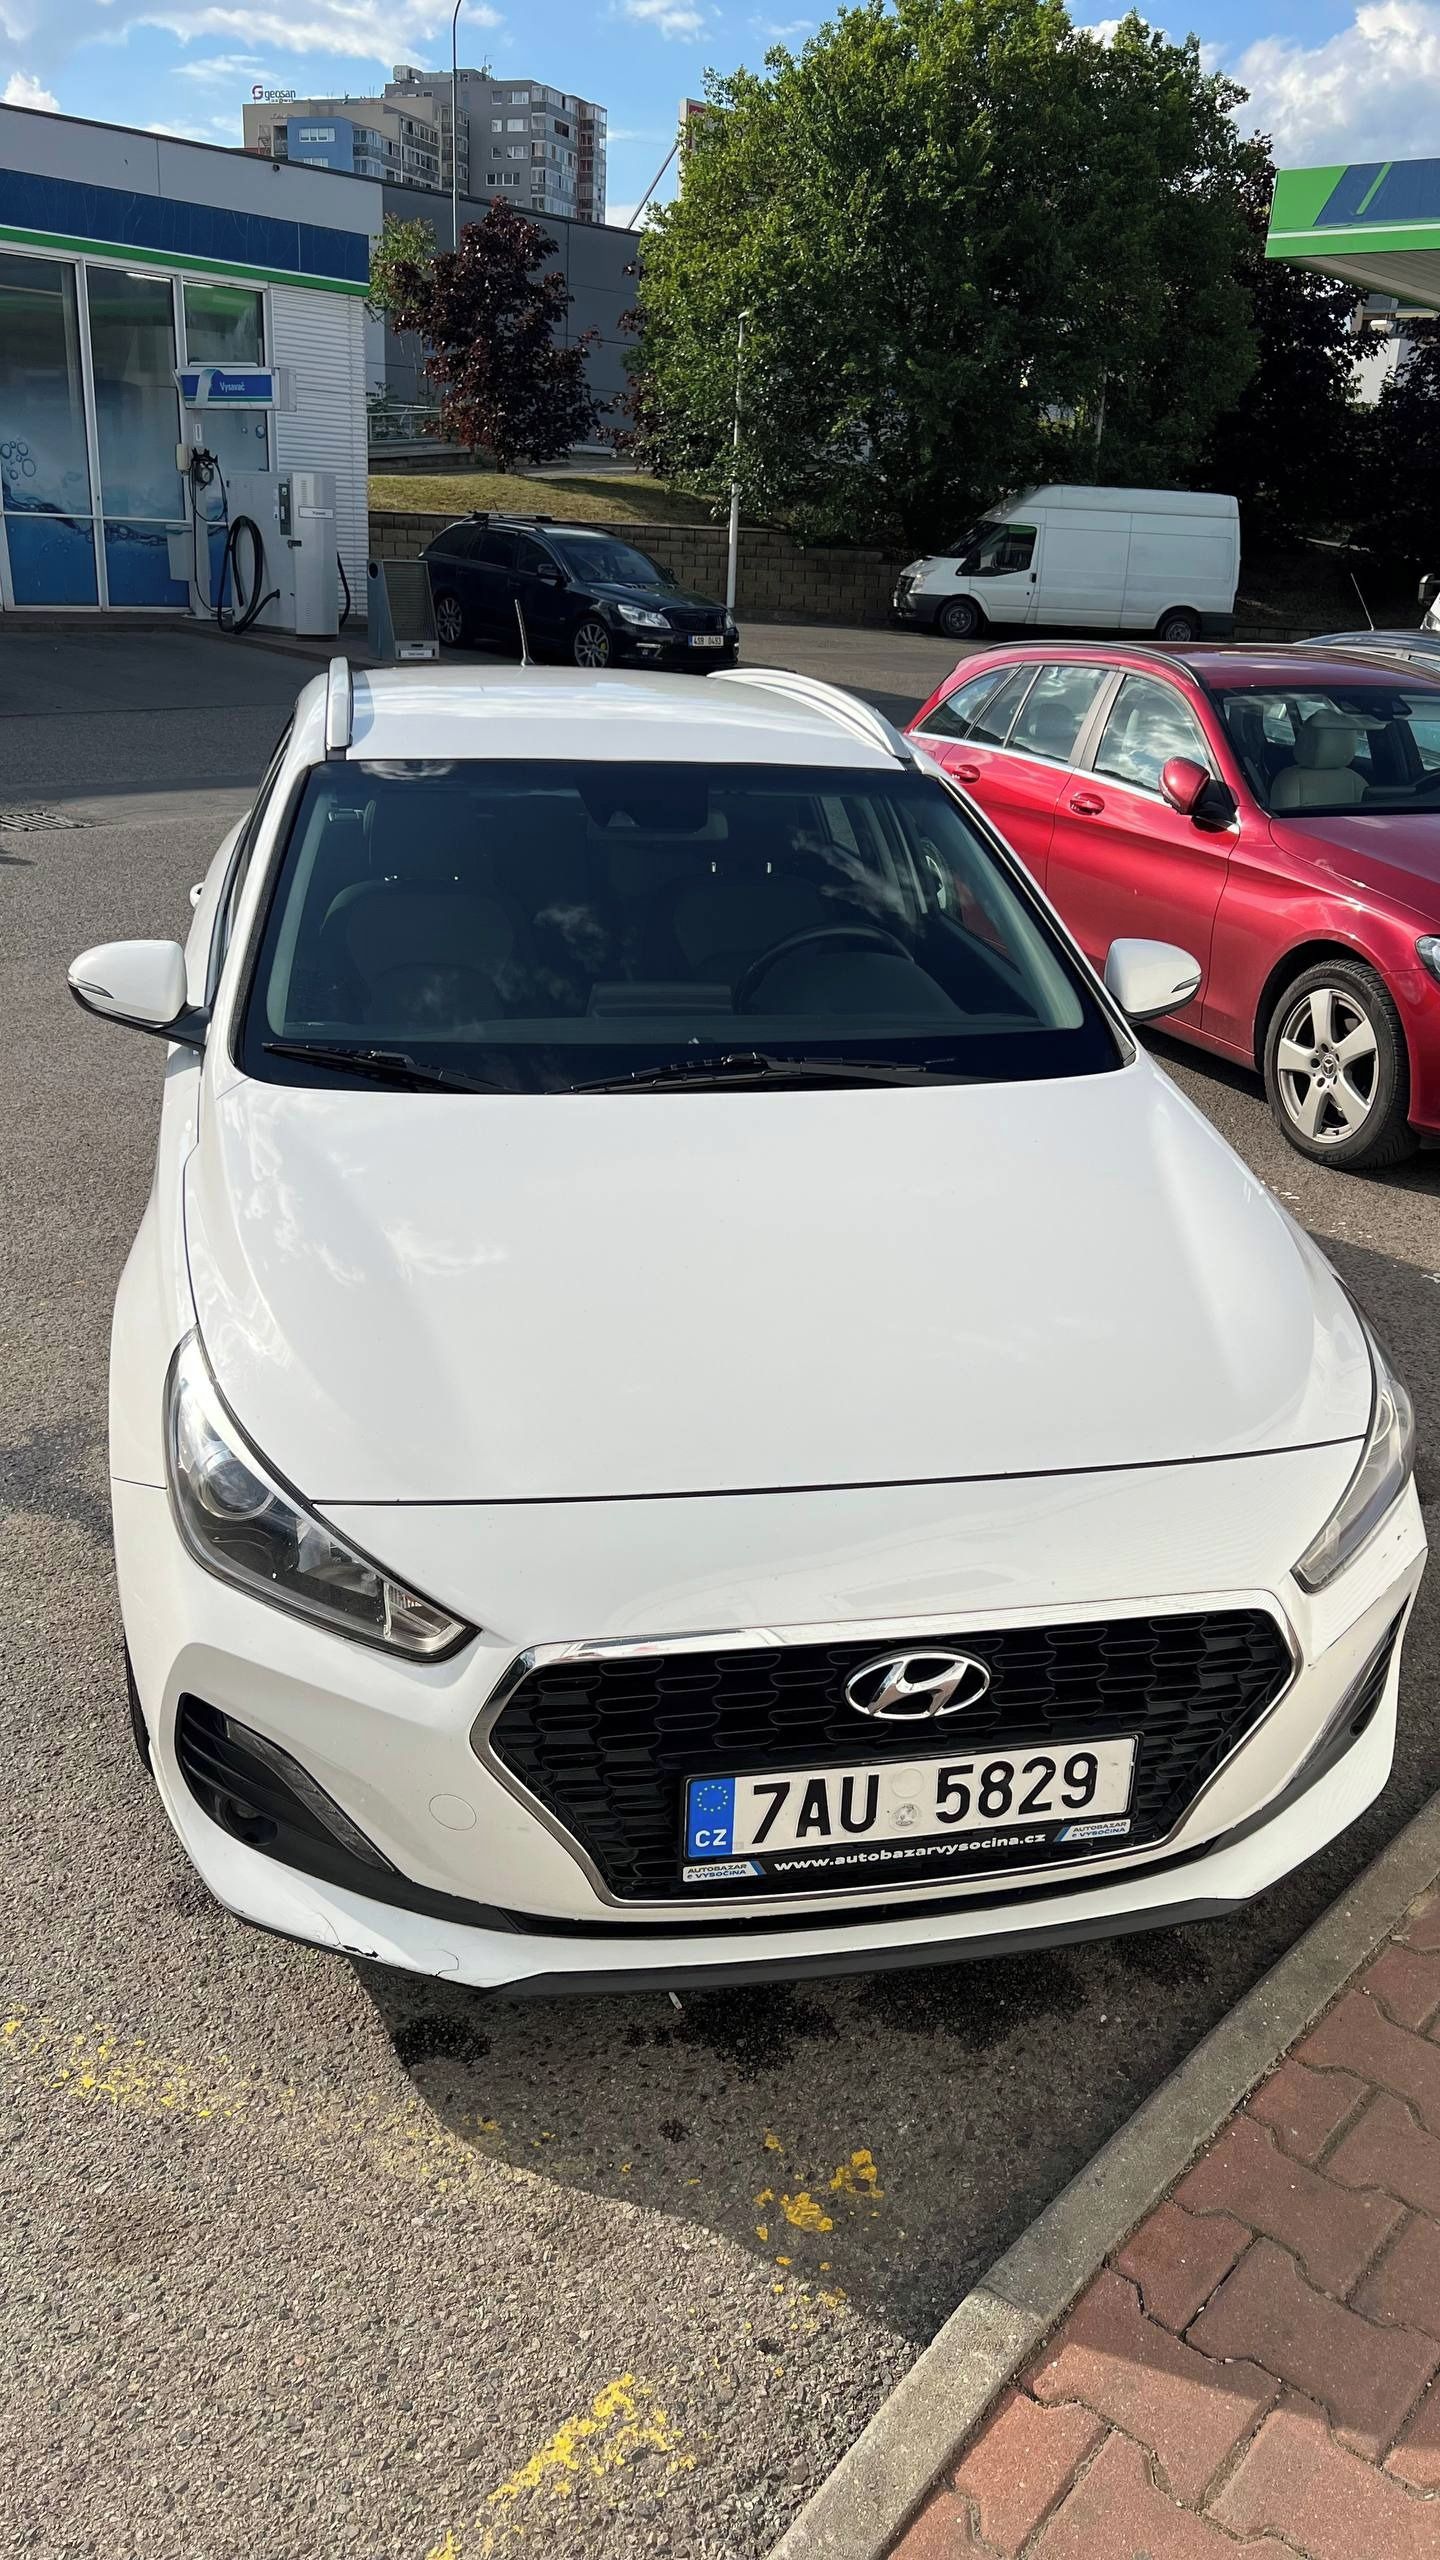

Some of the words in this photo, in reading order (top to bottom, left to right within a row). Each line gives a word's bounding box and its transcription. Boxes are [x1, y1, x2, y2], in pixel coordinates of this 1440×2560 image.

[265, 89, 296, 101] geosan
[220, 381, 245, 393] Vysavač
[752, 1774, 880, 1844] 7AU
[936, 1752, 1099, 1824] 5829
[1073, 1821, 1127, 1833] AUTOBAZAR
[695, 1829, 728, 1848] CZ
[774, 1833, 1046, 1871] www.autobazarvysocina.cz
[688, 1863, 747, 1874] AUTOBAZAR
